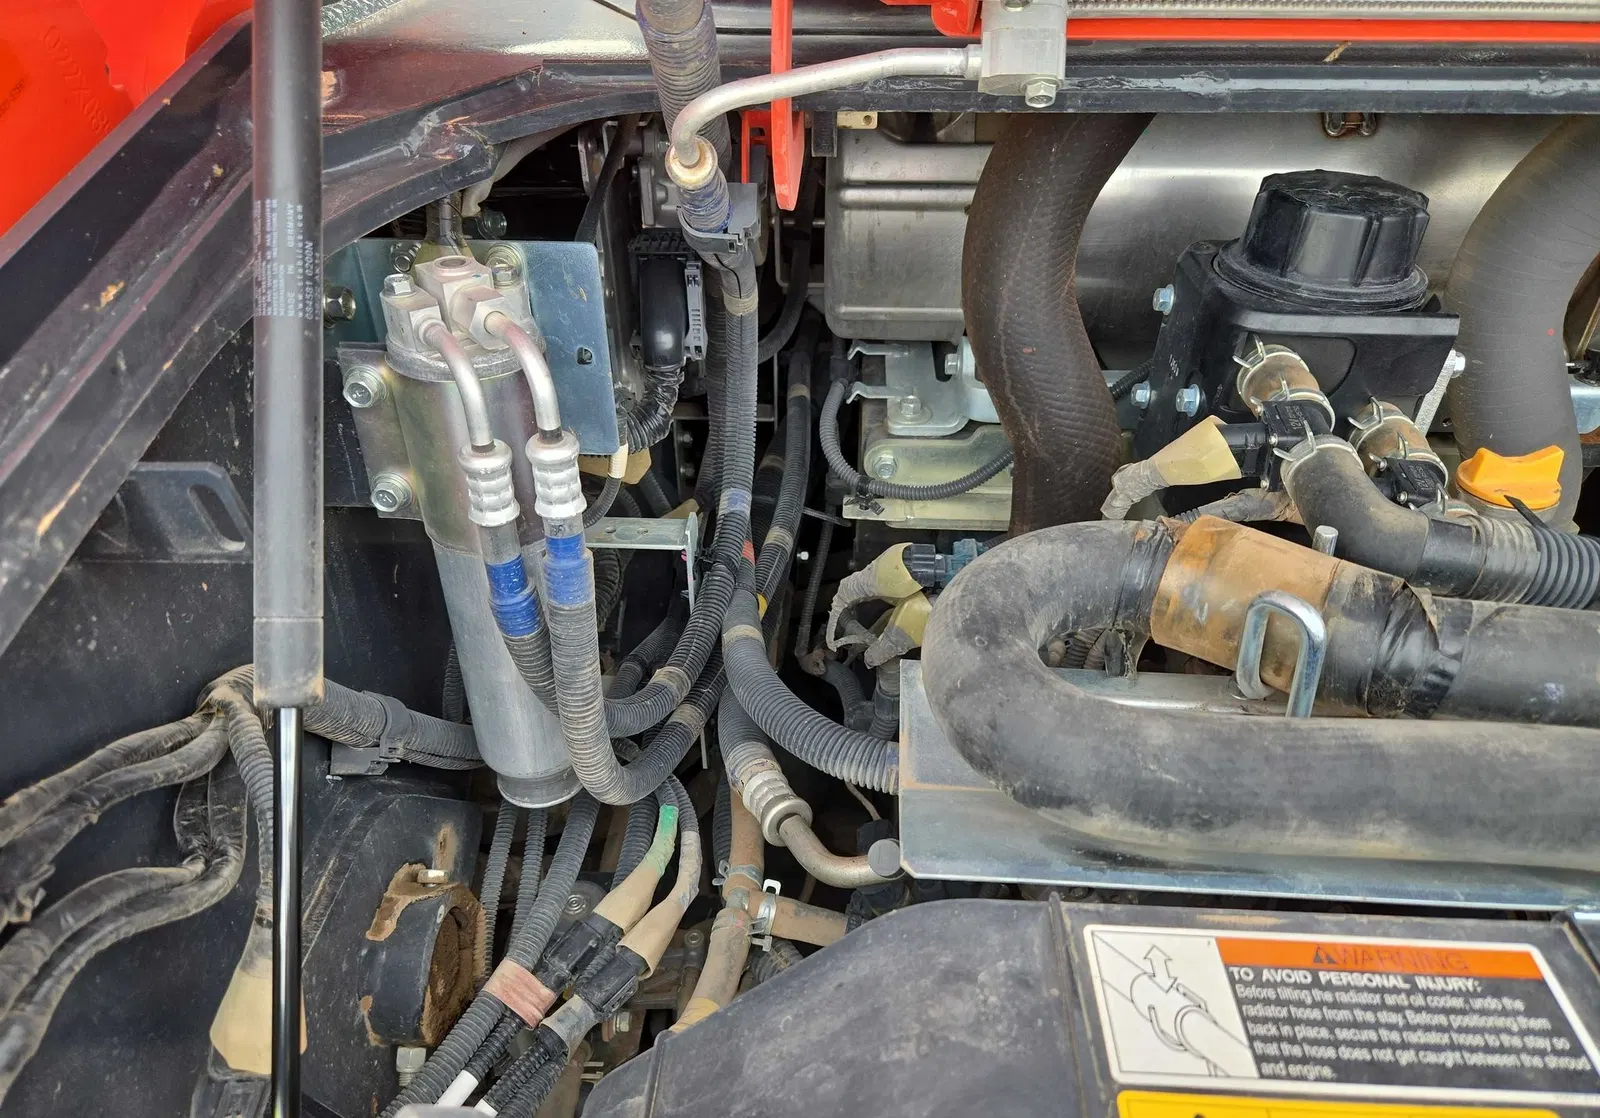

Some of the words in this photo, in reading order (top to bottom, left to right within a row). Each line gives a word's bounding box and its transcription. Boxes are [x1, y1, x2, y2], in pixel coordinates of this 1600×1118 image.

[287, 264, 295, 274] IN
[287, 291, 295, 316] MADE
[1338, 949, 1468, 970] WARNING
[1229, 966, 1255, 981] TO
[1262, 968, 1312, 985] AVOID
[1318, 971, 1411, 989] PERSONAL
[1414, 975, 1483, 993] INJURY:
[1235, 984, 1277, 1000] Before
[1278, 986, 1312, 1004] tilting
[1312, 988, 1334, 1003] the
[1335, 989, 1382, 1006] radiator
[1383, 991, 1408, 1007] and
[1409, 992, 1426, 1008] oil
[1470, 996, 1503, 1012] undo
[1502, 996, 1526, 1012] the
[1242, 1003, 1288, 1019] radiator
[1290, 1005, 1323, 1021] hose
[1323, 1007, 1353, 1022] from
[1353, 1008, 1376, 1024] the
[1405, 1009, 1449, 1027] Before
[1449, 1013, 1519, 1032] positioning
[1517, 1015, 1551, 1031] them
[1247, 1021, 1278, 1037] back
[1279, 1022, 1294, 1038] in
[1335, 1027, 1379, 1042] secure
[1379, 1028, 1402, 1044] the
[1403, 1029, 1451, 1046] radiator
[1451, 1031, 1485, 1047] hose
[1485, 1033, 1500, 1048] to
[1500, 1033, 1523, 1049] the
[1523, 1035, 1551, 1052] stay
[1551, 1037, 1571, 1051] so
[1254, 1039, 1280, 1056] that
[1280, 1041, 1303, 1057] the
[1304, 1042, 1337, 1059] hose
[1338, 1044, 1372, 1061] does
[1372, 1047, 1394, 1062] not
[1395, 1049, 1419, 1067] get
[1418, 1050, 1464, 1068] caught
[1463, 1051, 1521, 1068] between
[1521, 1052, 1544, 1068] the
[1544, 1055, 1592, 1072] shroud
[1260, 1061, 1287, 1077] and
[1288, 1064, 1337, 1081] engine.
